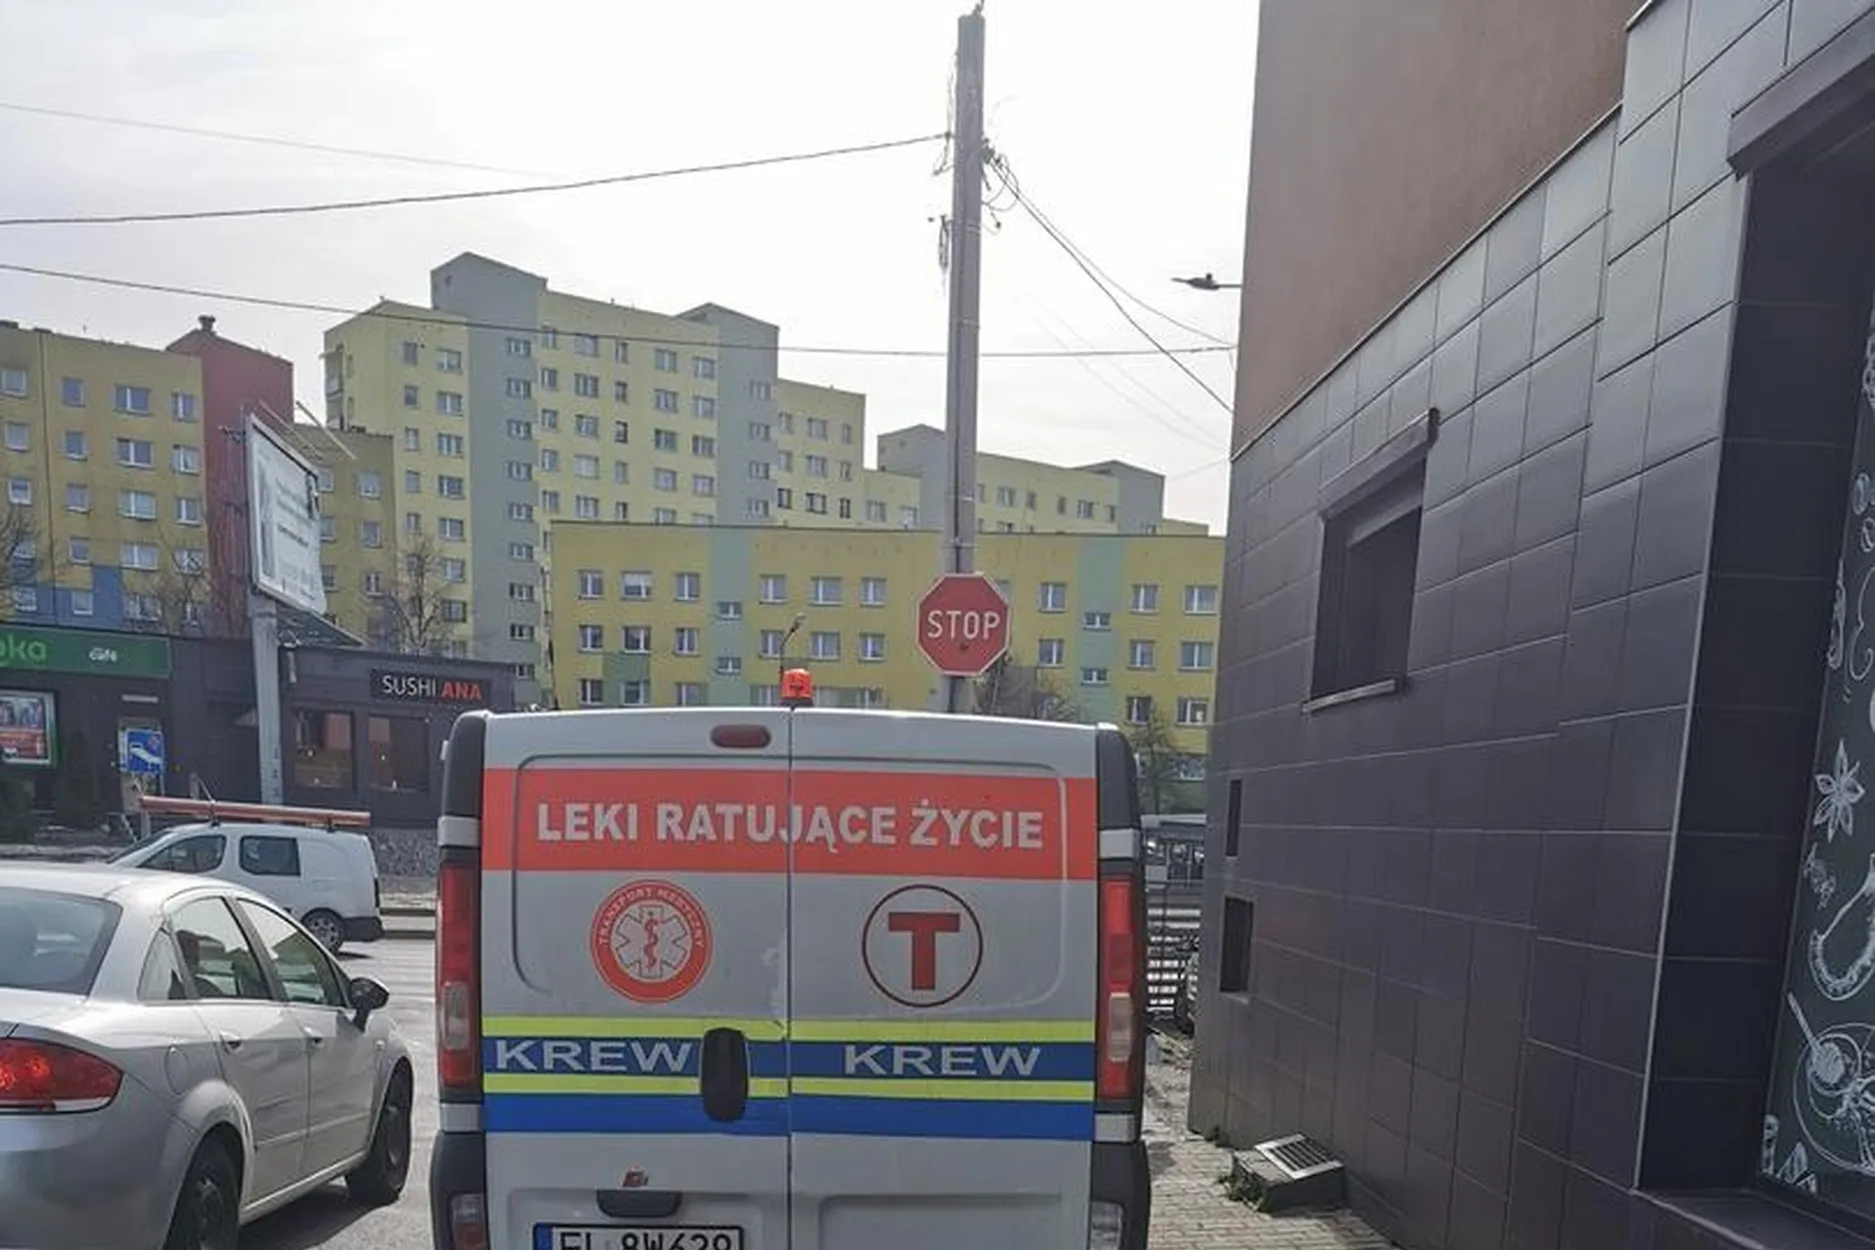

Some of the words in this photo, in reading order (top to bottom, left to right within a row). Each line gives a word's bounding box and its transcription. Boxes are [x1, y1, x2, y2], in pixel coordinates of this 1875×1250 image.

[927, 610, 1001, 639] STOP
[382, 675, 436, 697] SUSHI
[441, 682, 482, 700] ANA
[536, 802, 638, 842] LEKI
[656, 803, 897, 854] RATUJĄCE
[909, 799, 1044, 848] ŻYCIE
[888, 911, 960, 990] T
[495, 1039, 693, 1072] KREW
[844, 1044, 1041, 1076] KREW
